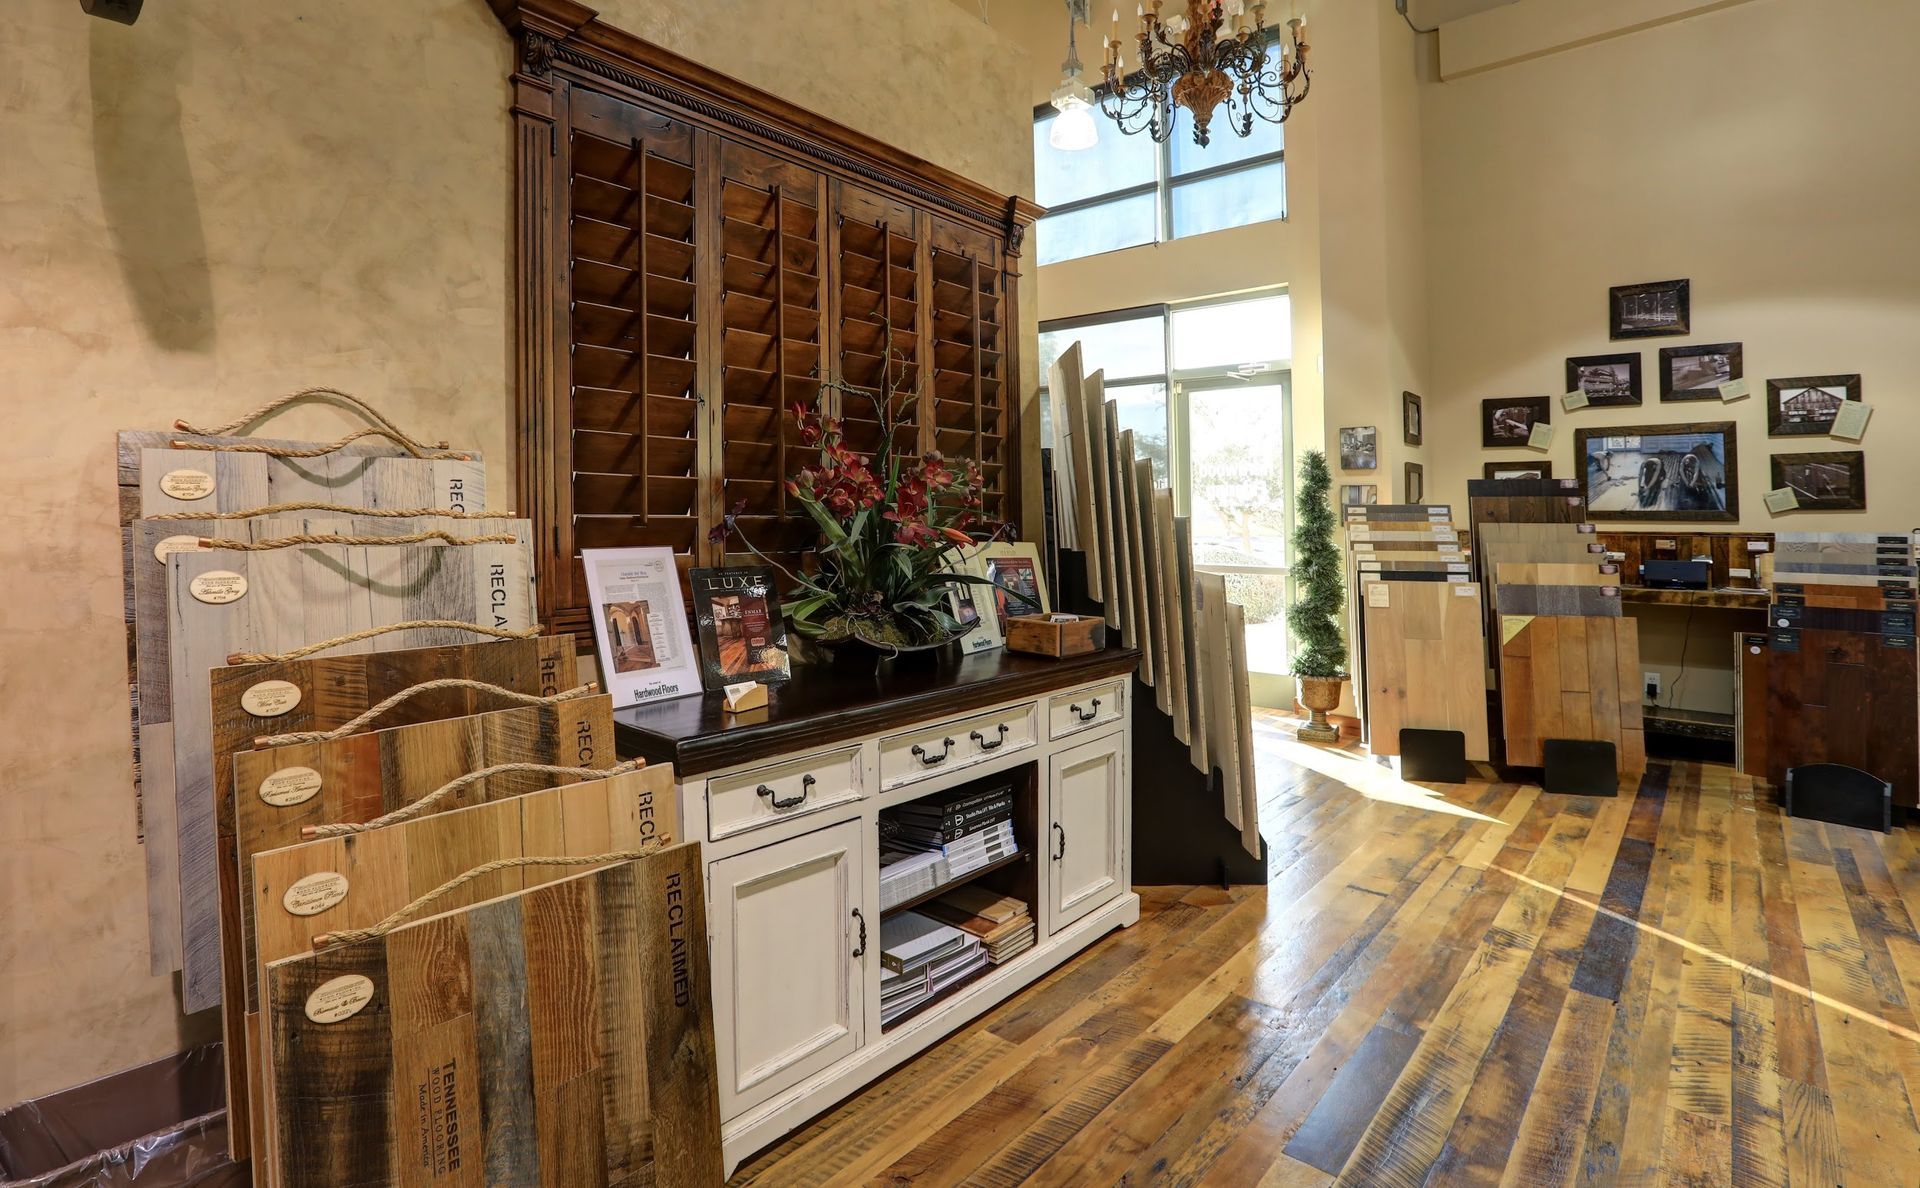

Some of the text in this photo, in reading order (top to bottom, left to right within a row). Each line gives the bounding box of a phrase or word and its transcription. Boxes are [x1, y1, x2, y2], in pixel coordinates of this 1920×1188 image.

[708, 576, 765, 589] LUXE
[634, 684, 679, 701] Hardwood Floors
[666, 873, 689, 1008] RECLAIMED
[419, 1082, 430, 1168] Made in America
[432, 1066, 446, 1174] WOOD FLOORING
[443, 1057, 460, 1173] TENNESSEE
